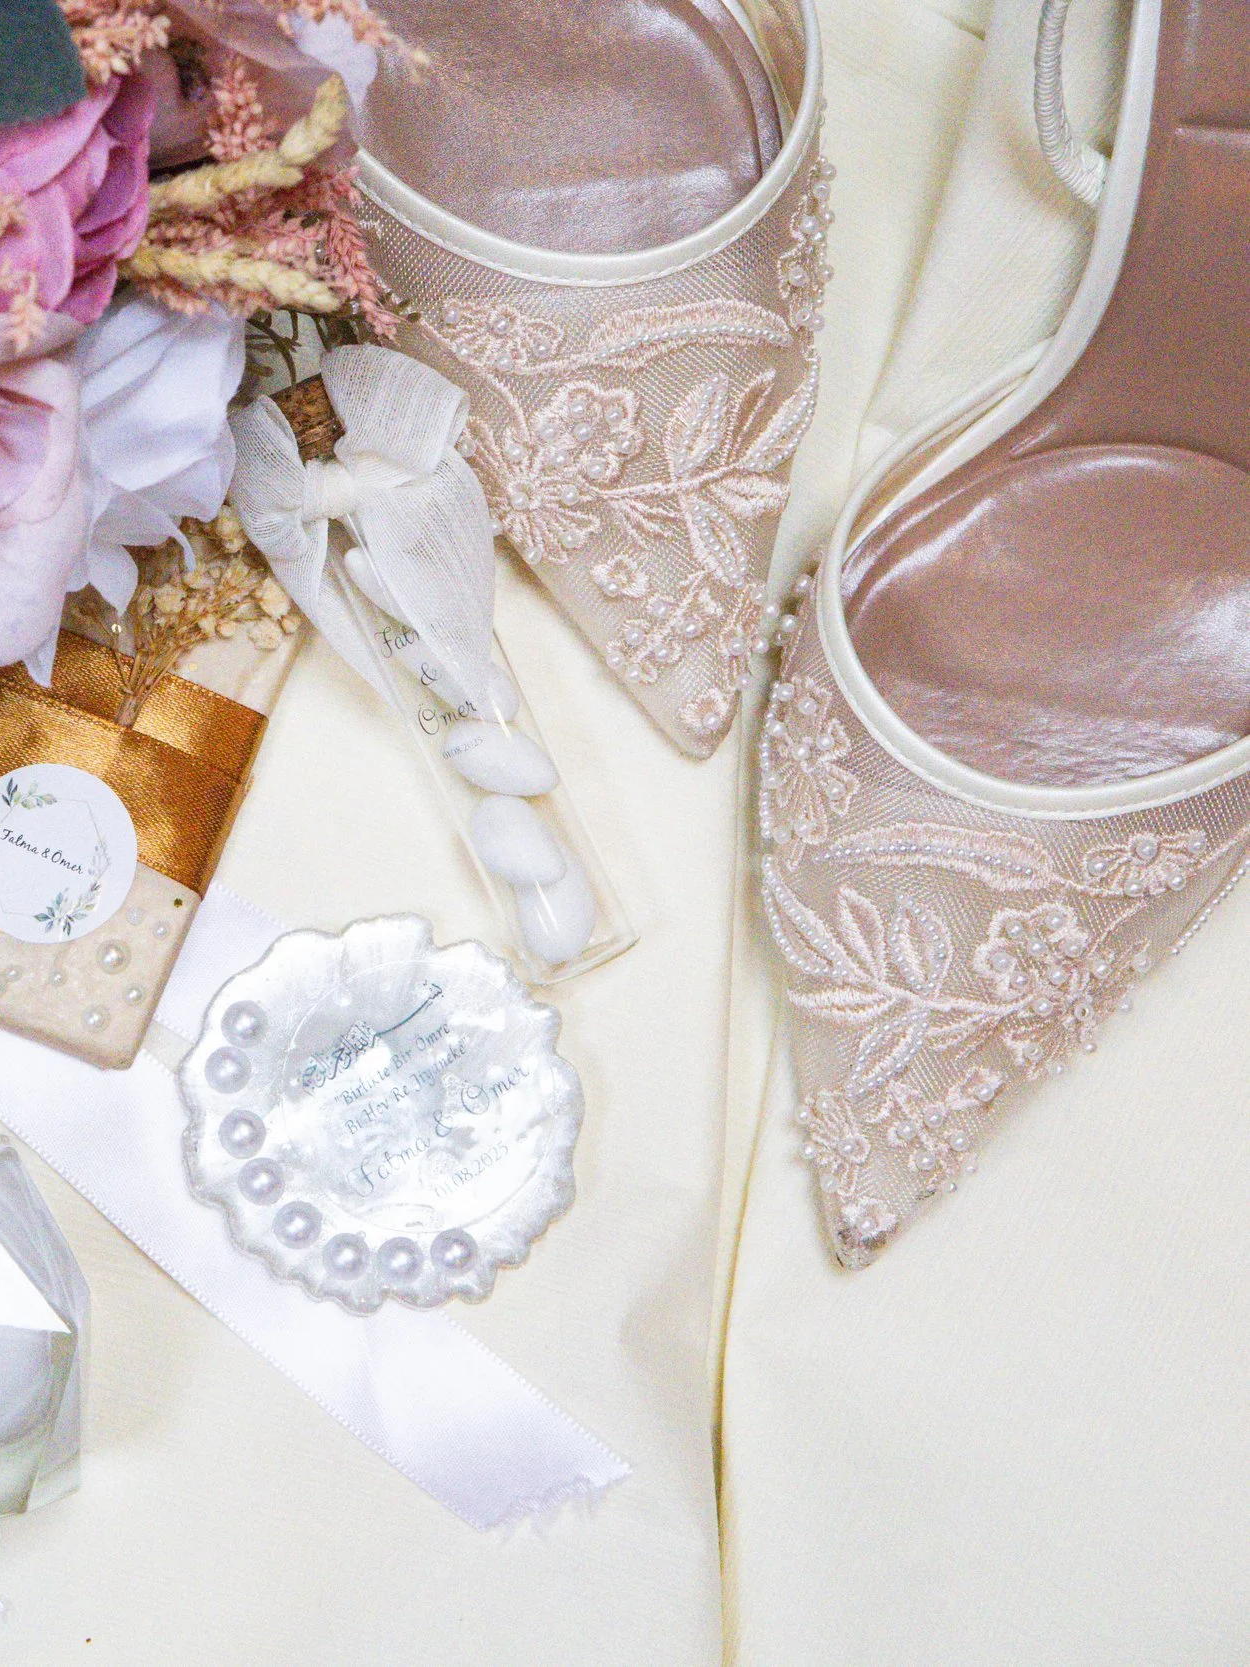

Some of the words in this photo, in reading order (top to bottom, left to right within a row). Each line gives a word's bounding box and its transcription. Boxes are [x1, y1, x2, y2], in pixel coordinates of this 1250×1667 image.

[420, 662, 439, 686] &
[417, 700, 477, 735] Ömer
[40, 847, 51, 859] &
[51, 849, 84, 875] Ömer
[433, 1108, 453, 1138] &
[460, 1066, 530, 1115] Ömer
